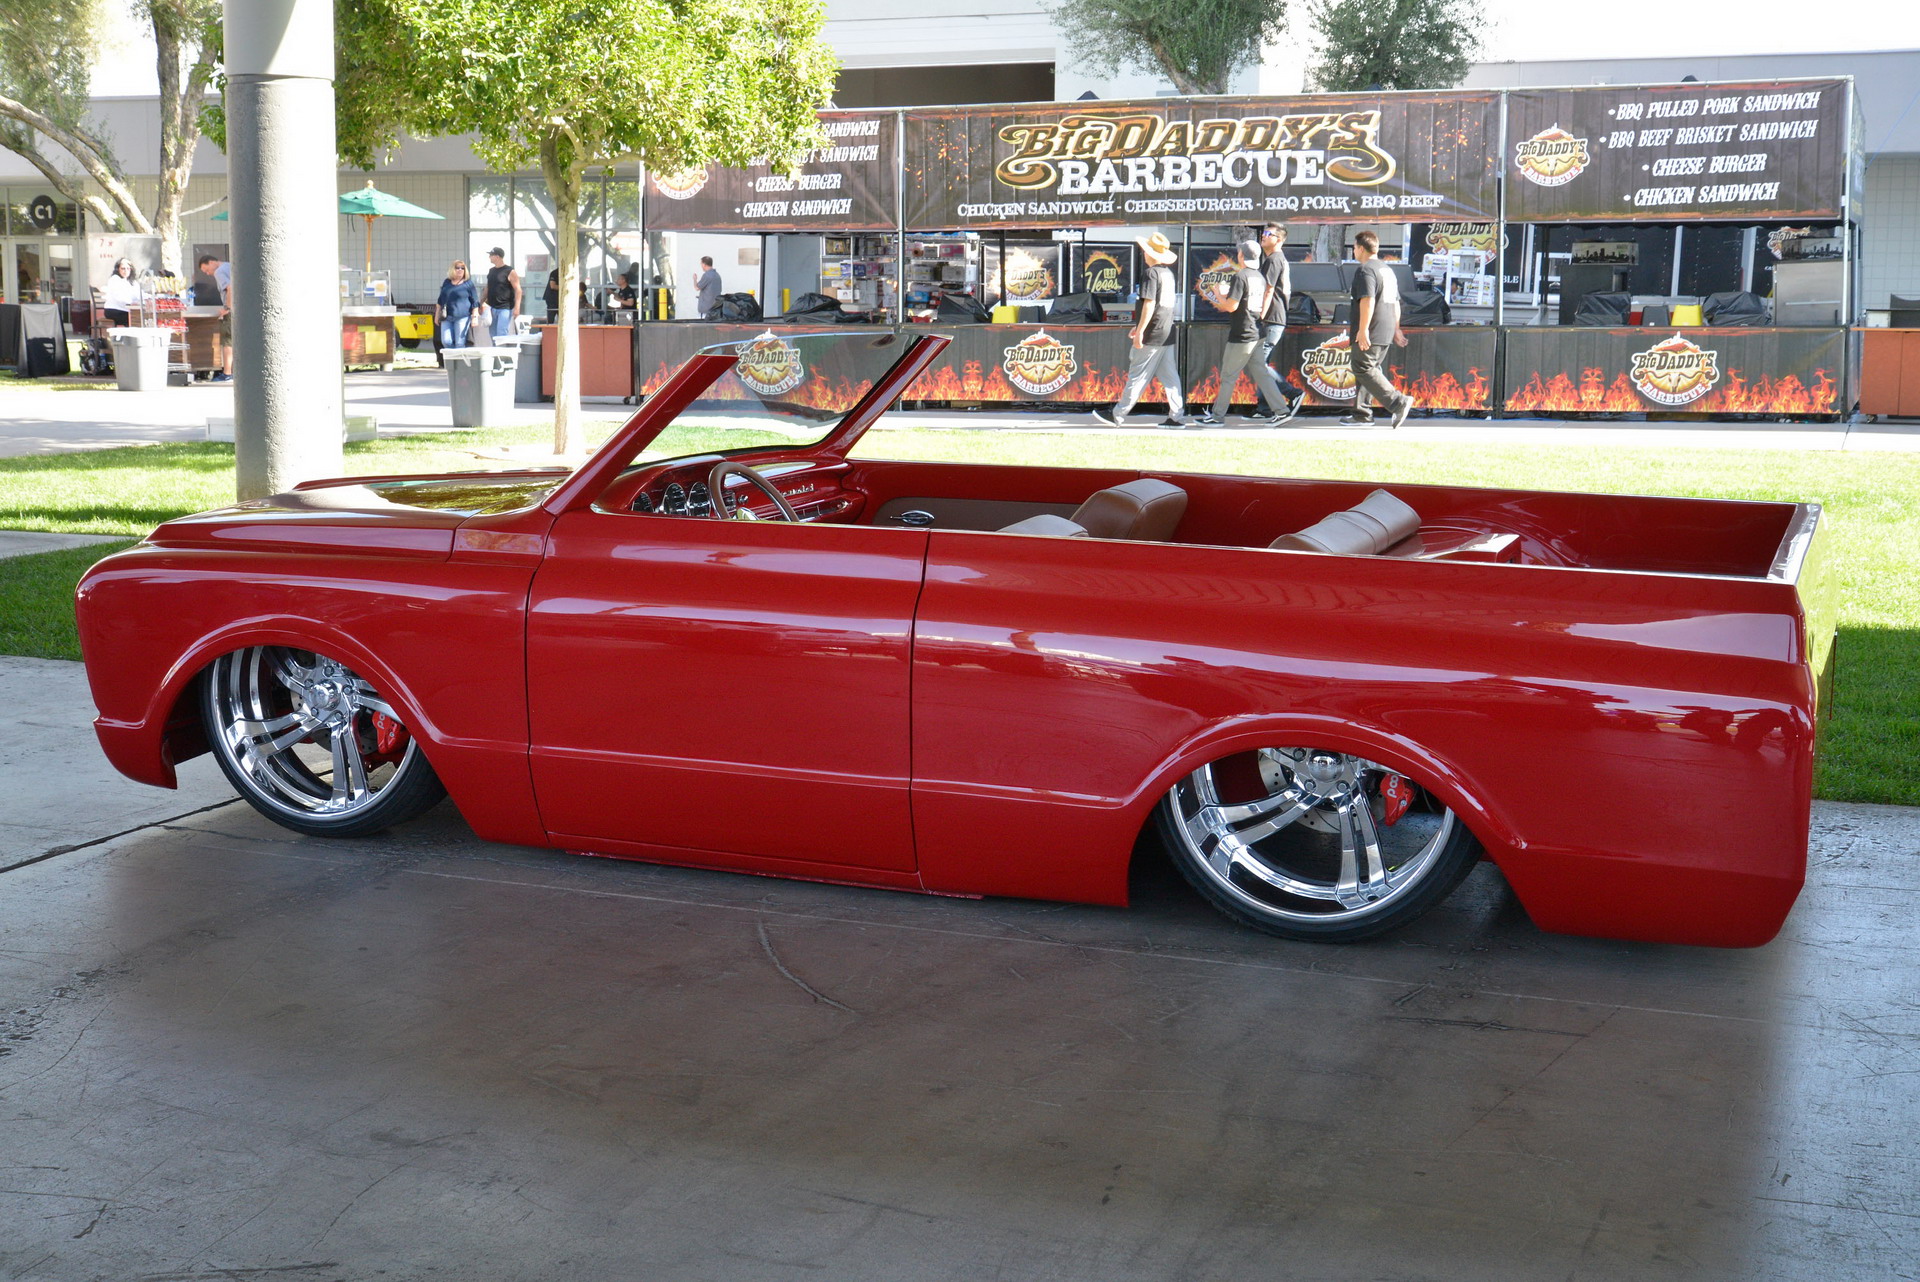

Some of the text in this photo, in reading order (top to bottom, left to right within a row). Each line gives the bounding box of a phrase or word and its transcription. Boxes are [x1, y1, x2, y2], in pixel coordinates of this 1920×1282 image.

[1616, 91, 1821, 120] BBQ PULLED PORK SANDWICH
[823, 120, 881, 137] SANDWICH
[1608, 119, 1819, 149] BBQ BEEF BRISKET SANDWICH
[820, 145, 879, 163] SANDWICH
[1060, 110, 1397, 186] DADDY'S
[1535, 140, 1586, 157] DADDY'S
[1057, 149, 1325, 196] BARBECUE
[1652, 153, 1768, 177] CHEESE BURGER
[755, 173, 842, 193] CHEESE BURGER
[1524, 166, 1579, 185] BARBECUE
[1634, 182, 1780, 206] CHICKEN SANDWICH
[34, 205, 53, 220] C1
[743, 198, 853, 218] CHICKEN SANDWICH
[957, 202, 1025, 220] CHICKEN
[1028, 199, 1115, 216] SANDWICH
[1124, 198, 1254, 214] CHEESEBURGER
[1264, 196, 1299, 212] BBQ
[1301, 195, 1351, 213] PORK
[1360, 195, 1397, 211] BBQ
[1399, 194, 1444, 209] BEEF
[1022, 345, 1073, 363] DADDY'S
[1654, 351, 1715, 370] DADDY'S
[745, 374, 795, 393] BARBECUE
[1014, 374, 1066, 393] BARBECUE
[1312, 377, 1357, 398] BARBEC
[1642, 382, 1706, 403] BARBECUE
